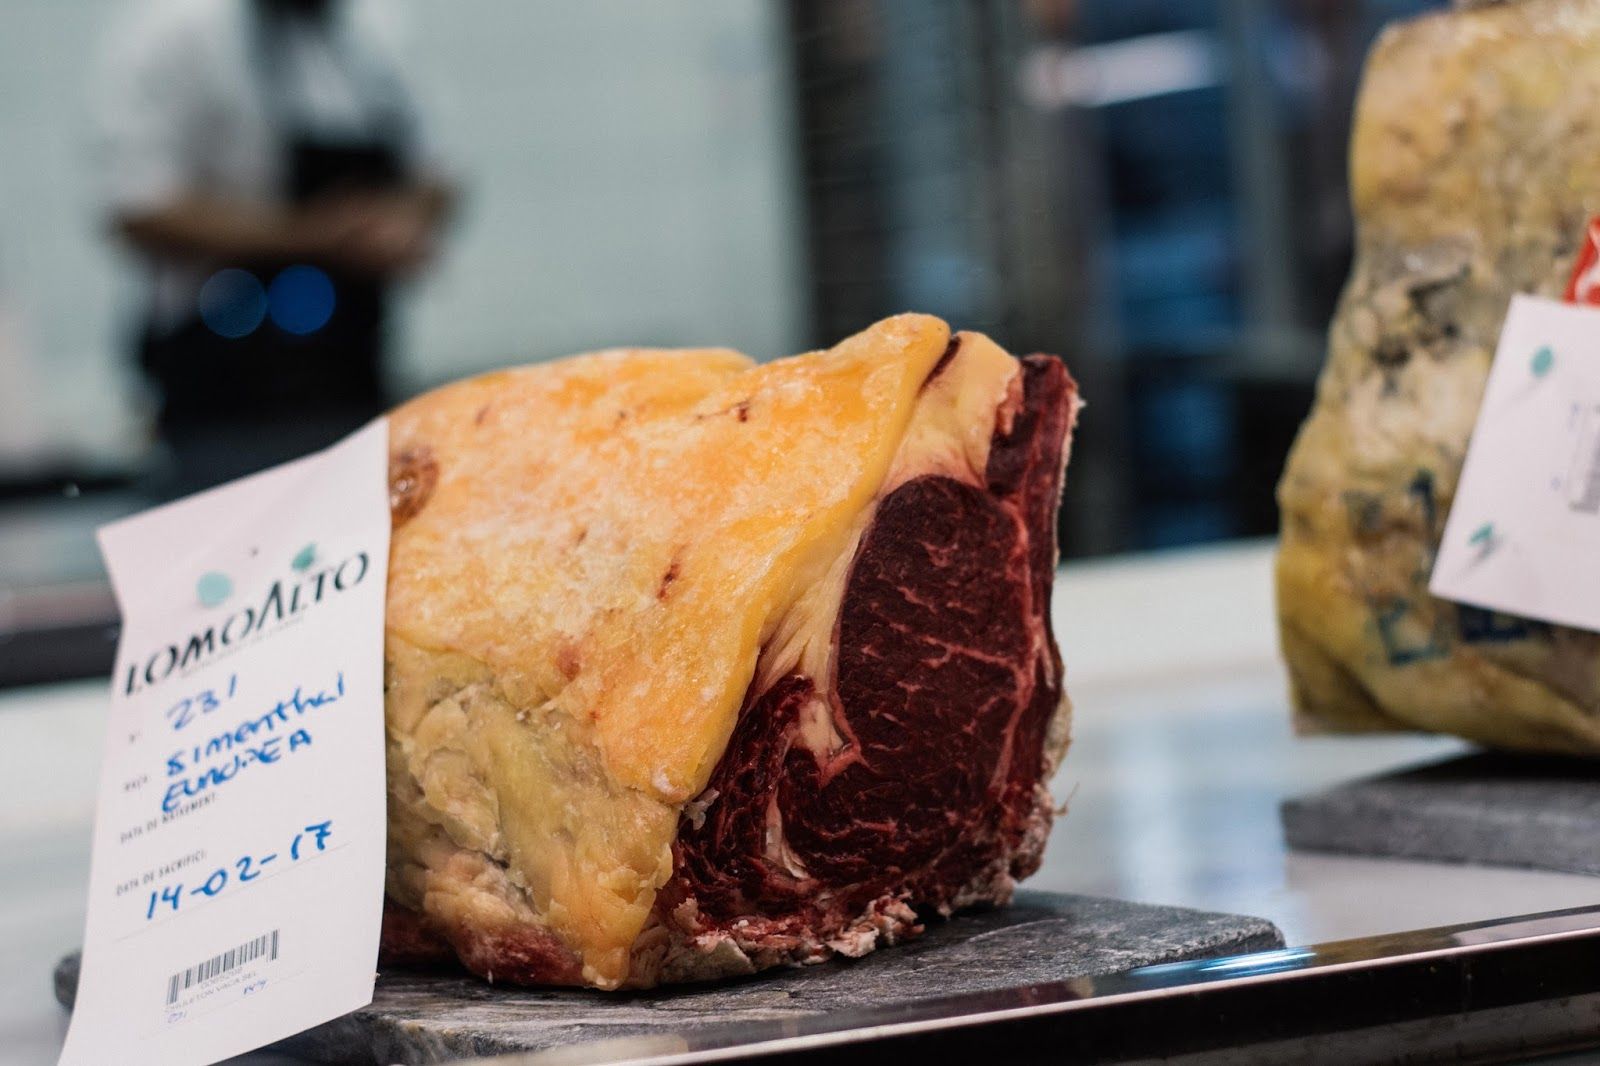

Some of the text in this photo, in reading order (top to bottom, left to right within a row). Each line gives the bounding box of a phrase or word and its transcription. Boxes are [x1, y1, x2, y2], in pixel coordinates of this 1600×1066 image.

[124, 551, 370, 696] LOMOALTO
[120, 826, 143, 844] DATA
[116, 878, 139, 896] DATA
[143, 871, 155, 884] DE
